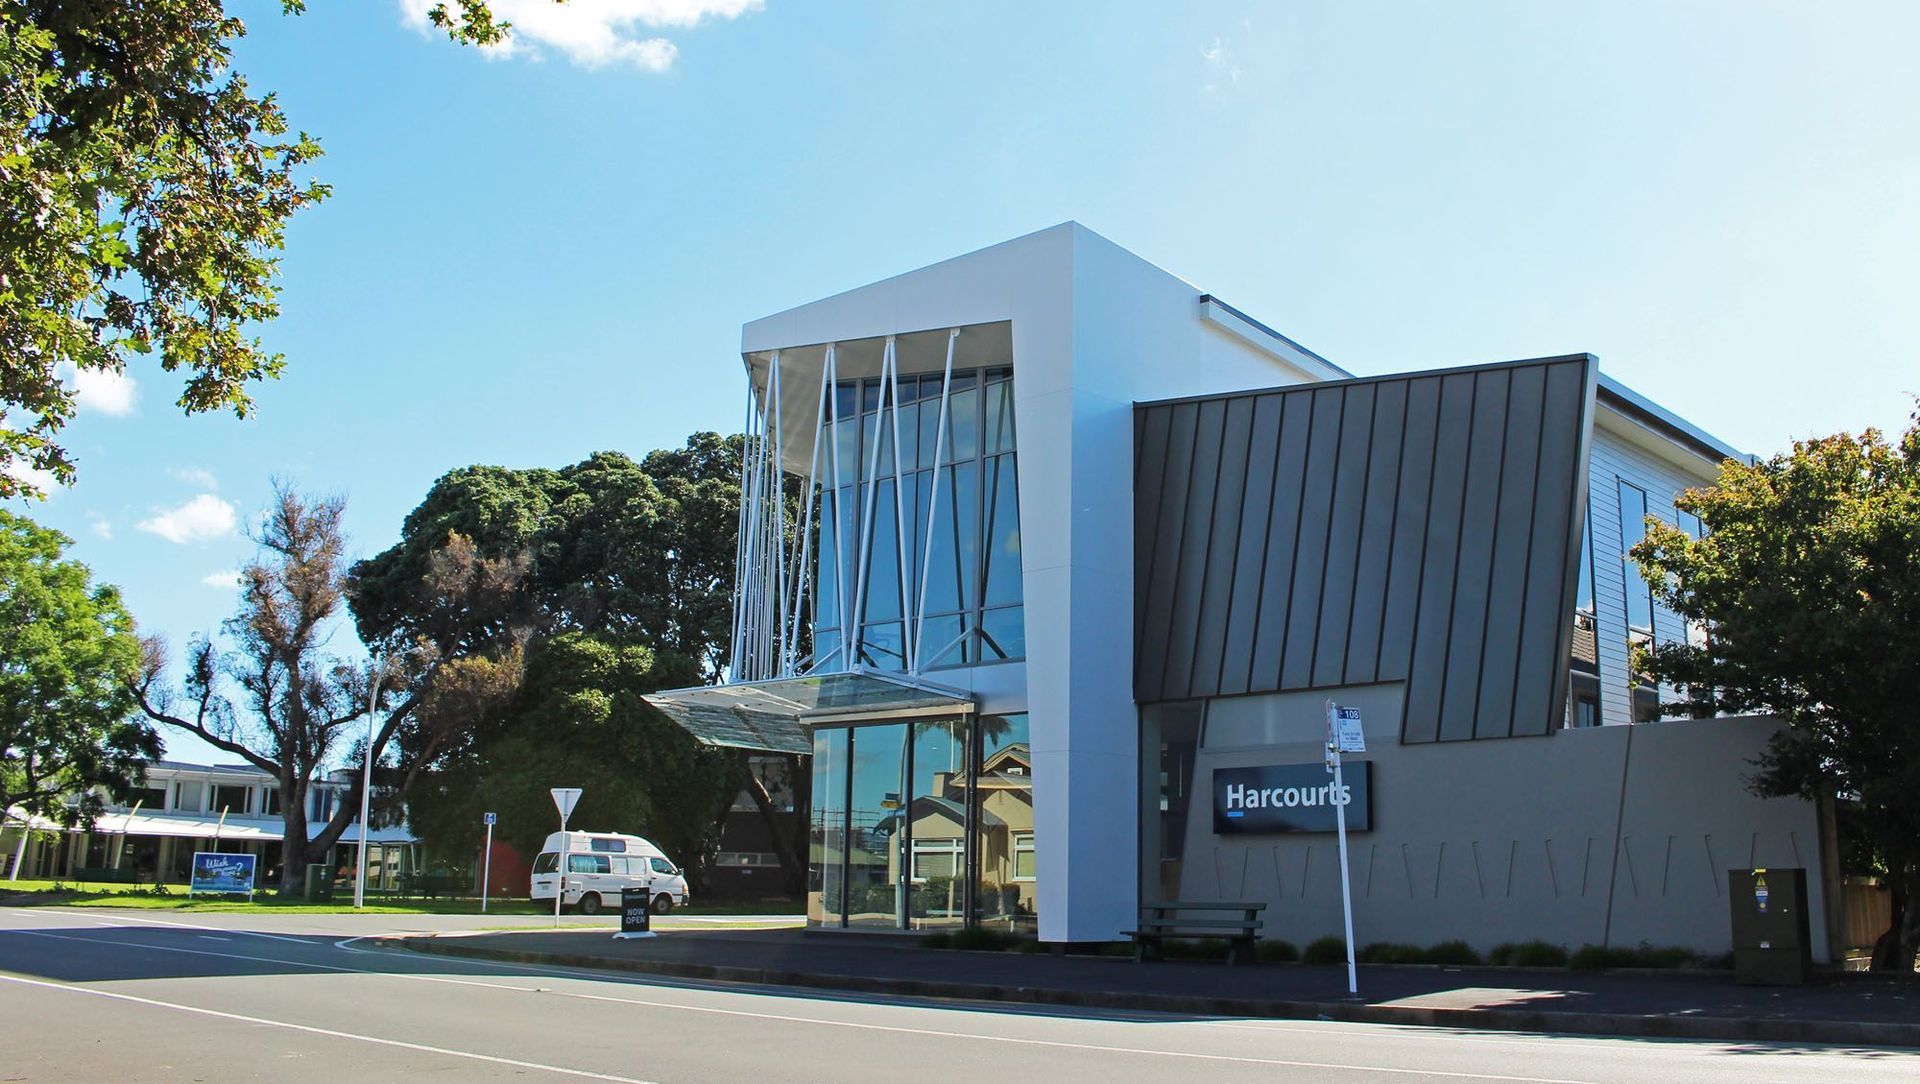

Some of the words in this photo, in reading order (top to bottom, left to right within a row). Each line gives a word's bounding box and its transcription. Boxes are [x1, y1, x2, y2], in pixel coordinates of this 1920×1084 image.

[1227, 782, 1351, 809] Harcourts
[627, 908, 645, 916] NOW
[626, 916, 646, 924] OPEN
